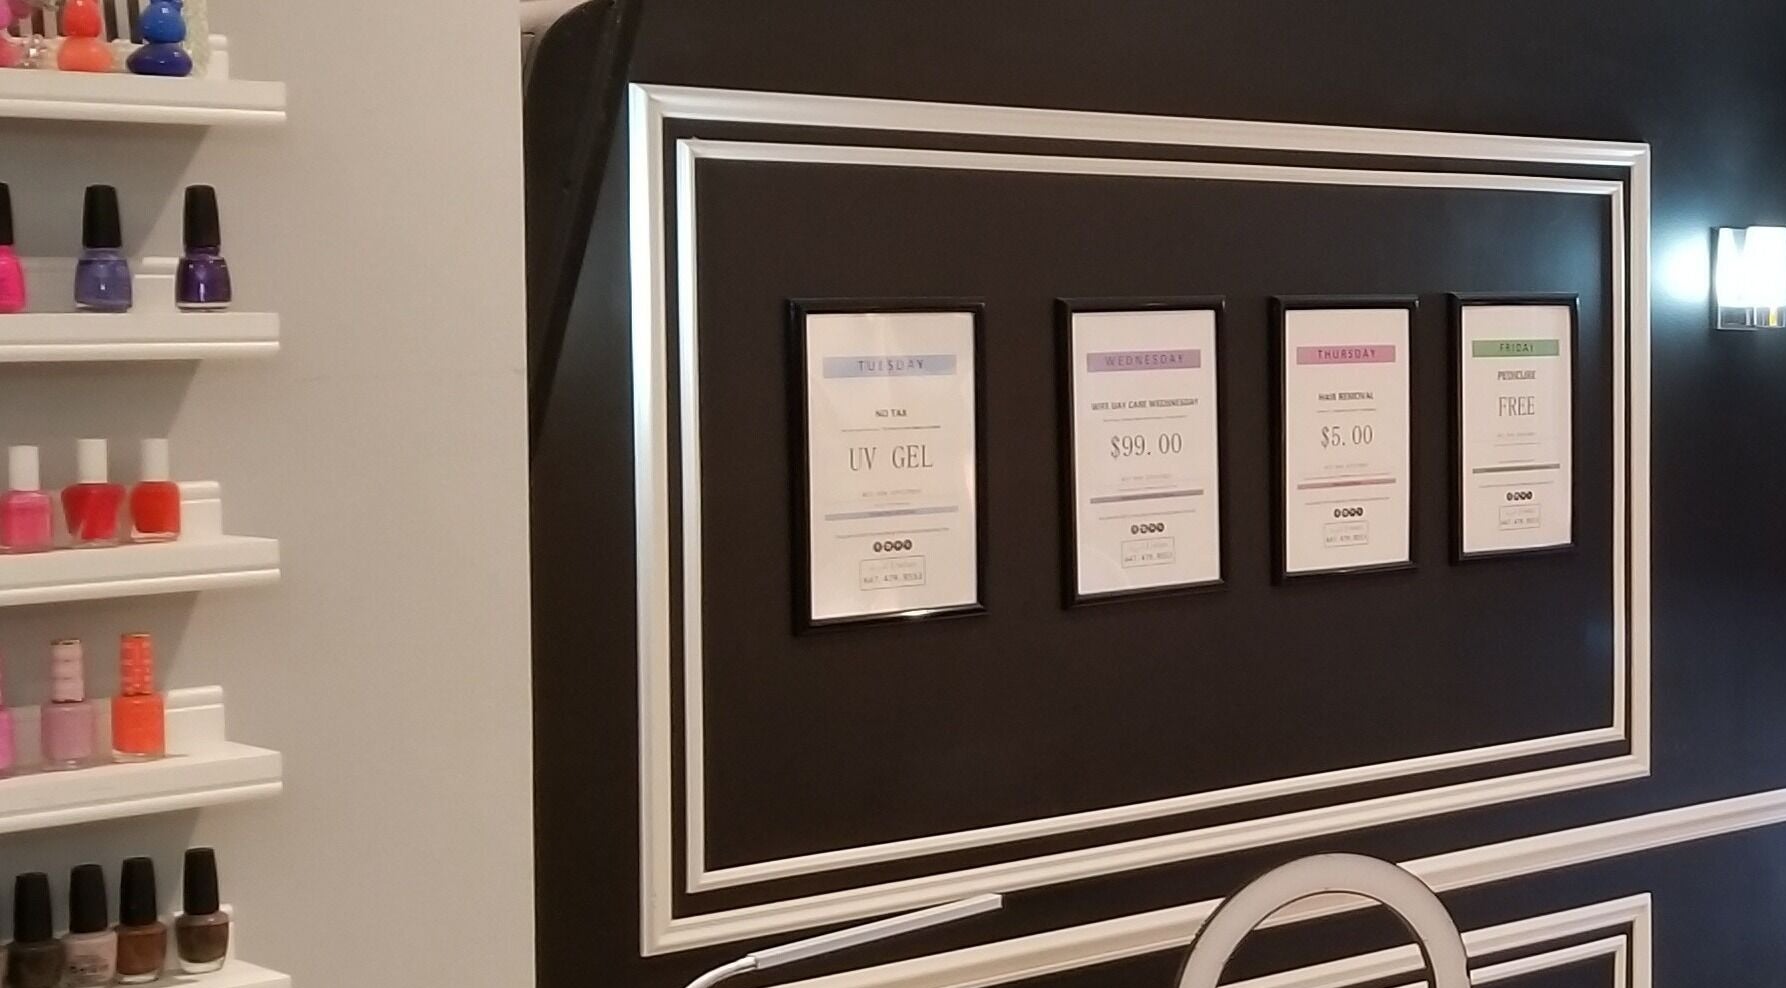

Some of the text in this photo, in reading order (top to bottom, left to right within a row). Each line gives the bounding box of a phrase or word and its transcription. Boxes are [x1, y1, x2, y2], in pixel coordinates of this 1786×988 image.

[1318, 348, 1376, 360] THURSDAY
[1499, 343, 1535, 353] FRIDAY
[857, 359, 925, 372] TUESDAY
[1105, 353, 1185, 367] WEDNESDAY
[1338, 391, 1374, 401] REMOVAL
[1498, 395, 1536, 417] FREE
[849, 444, 933, 472] UV GEL
